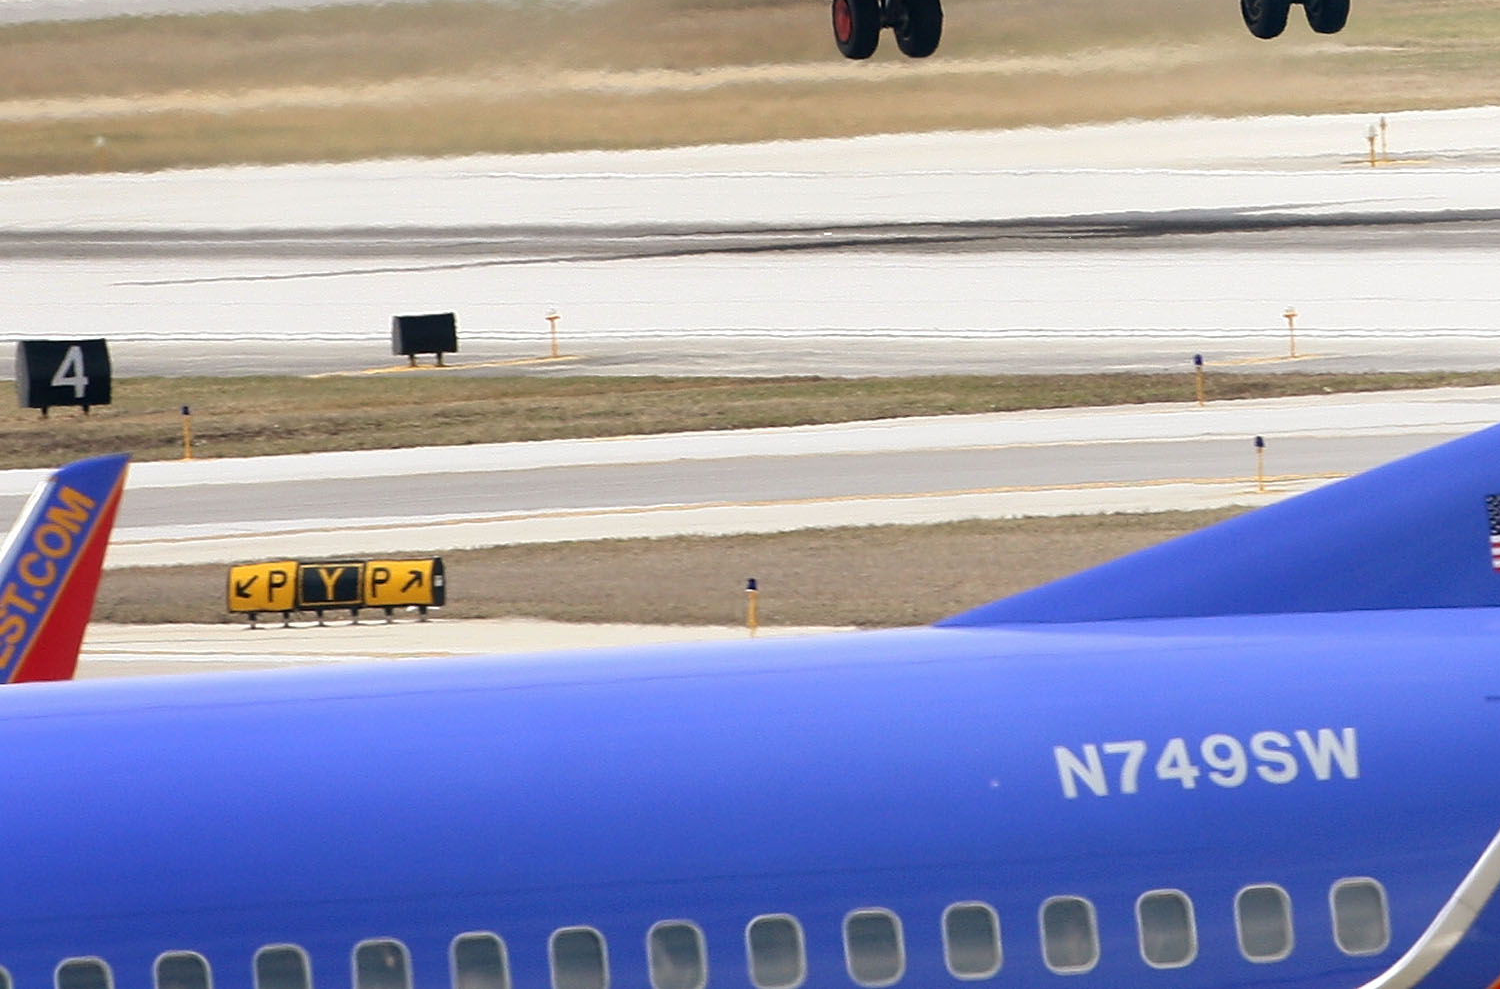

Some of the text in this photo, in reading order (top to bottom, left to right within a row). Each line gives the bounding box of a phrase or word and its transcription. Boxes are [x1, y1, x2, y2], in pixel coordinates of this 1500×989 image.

[51, 345, 89, 399] 4
[269, 567, 390, 602] P Y P
[1053, 727, 1359, 799] N749SW
